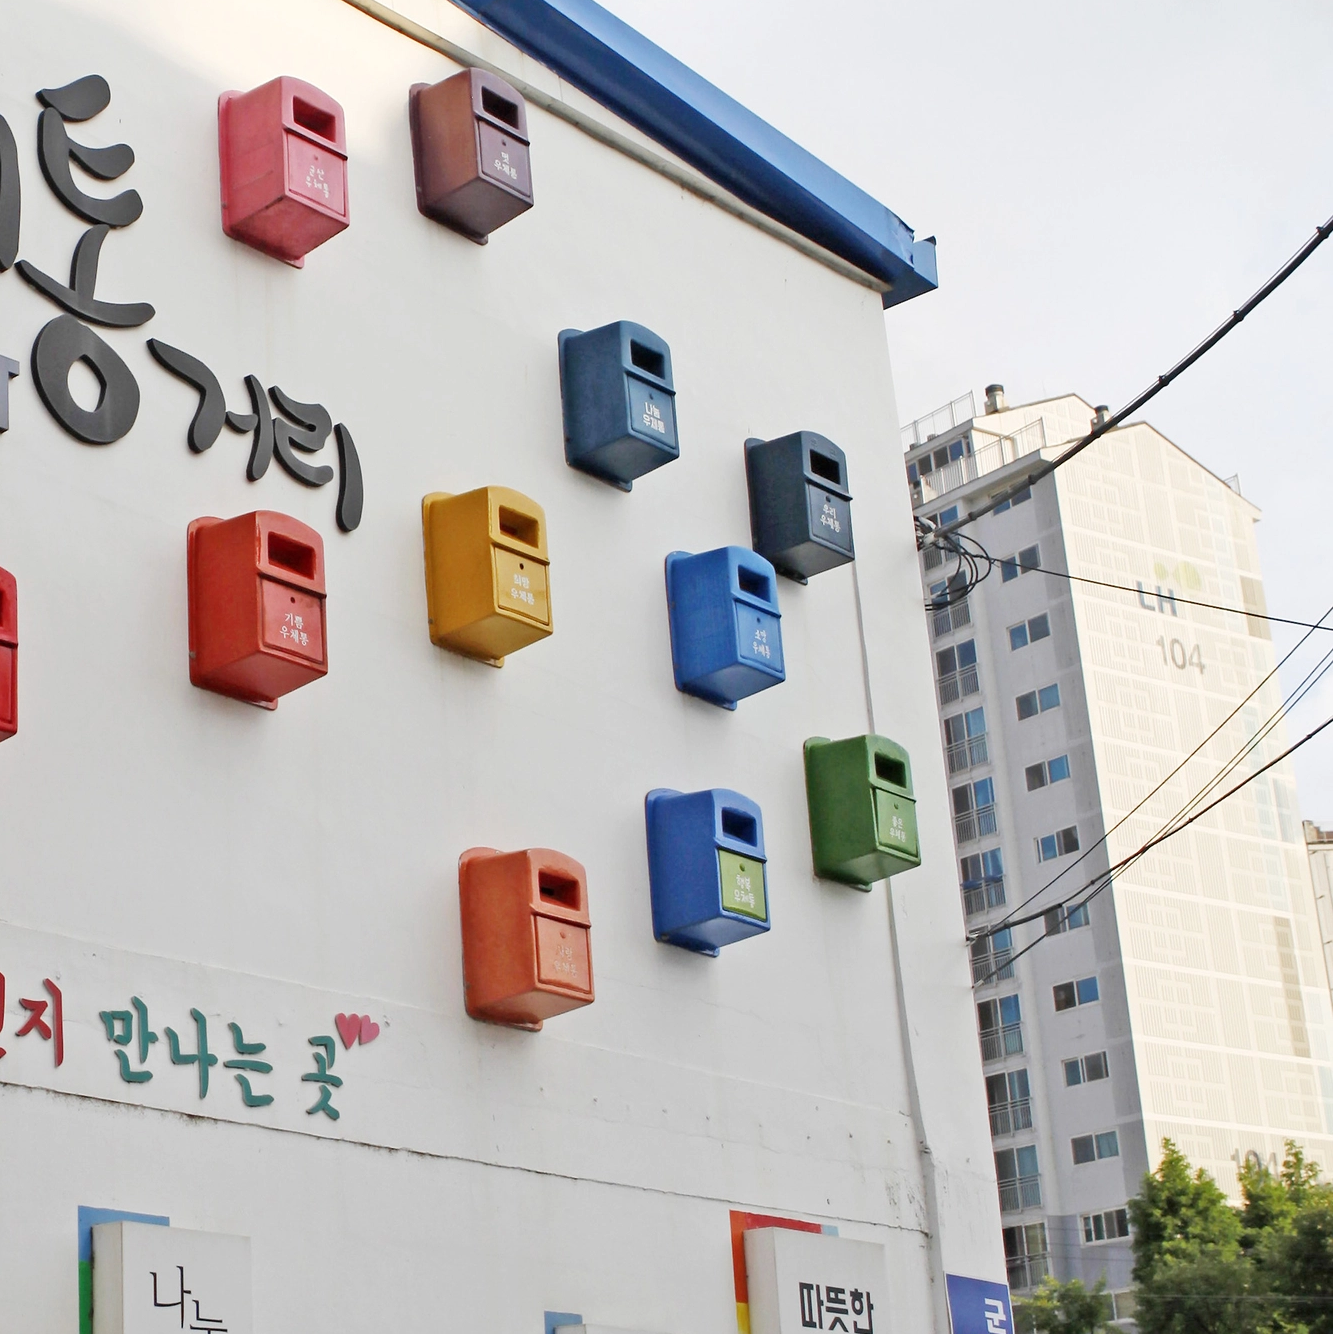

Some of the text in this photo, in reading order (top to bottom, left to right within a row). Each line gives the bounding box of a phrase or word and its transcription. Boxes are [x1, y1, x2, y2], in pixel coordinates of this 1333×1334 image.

[494, 159, 518, 180] 우체통
[642, 413, 666, 434] 우체통
[146, 337, 364, 533] 거리
[822, 504, 837, 519] 우리
[819, 514, 842, 533] 우체통
[510, 587, 535, 606] 우체통
[1136, 580, 1178, 617] LH
[279, 625, 309, 647] 우체통
[1156, 634, 1206, 675] 104
[99, 995, 274, 1108] 만나는
[300, 1034, 344, 1121] 곳
